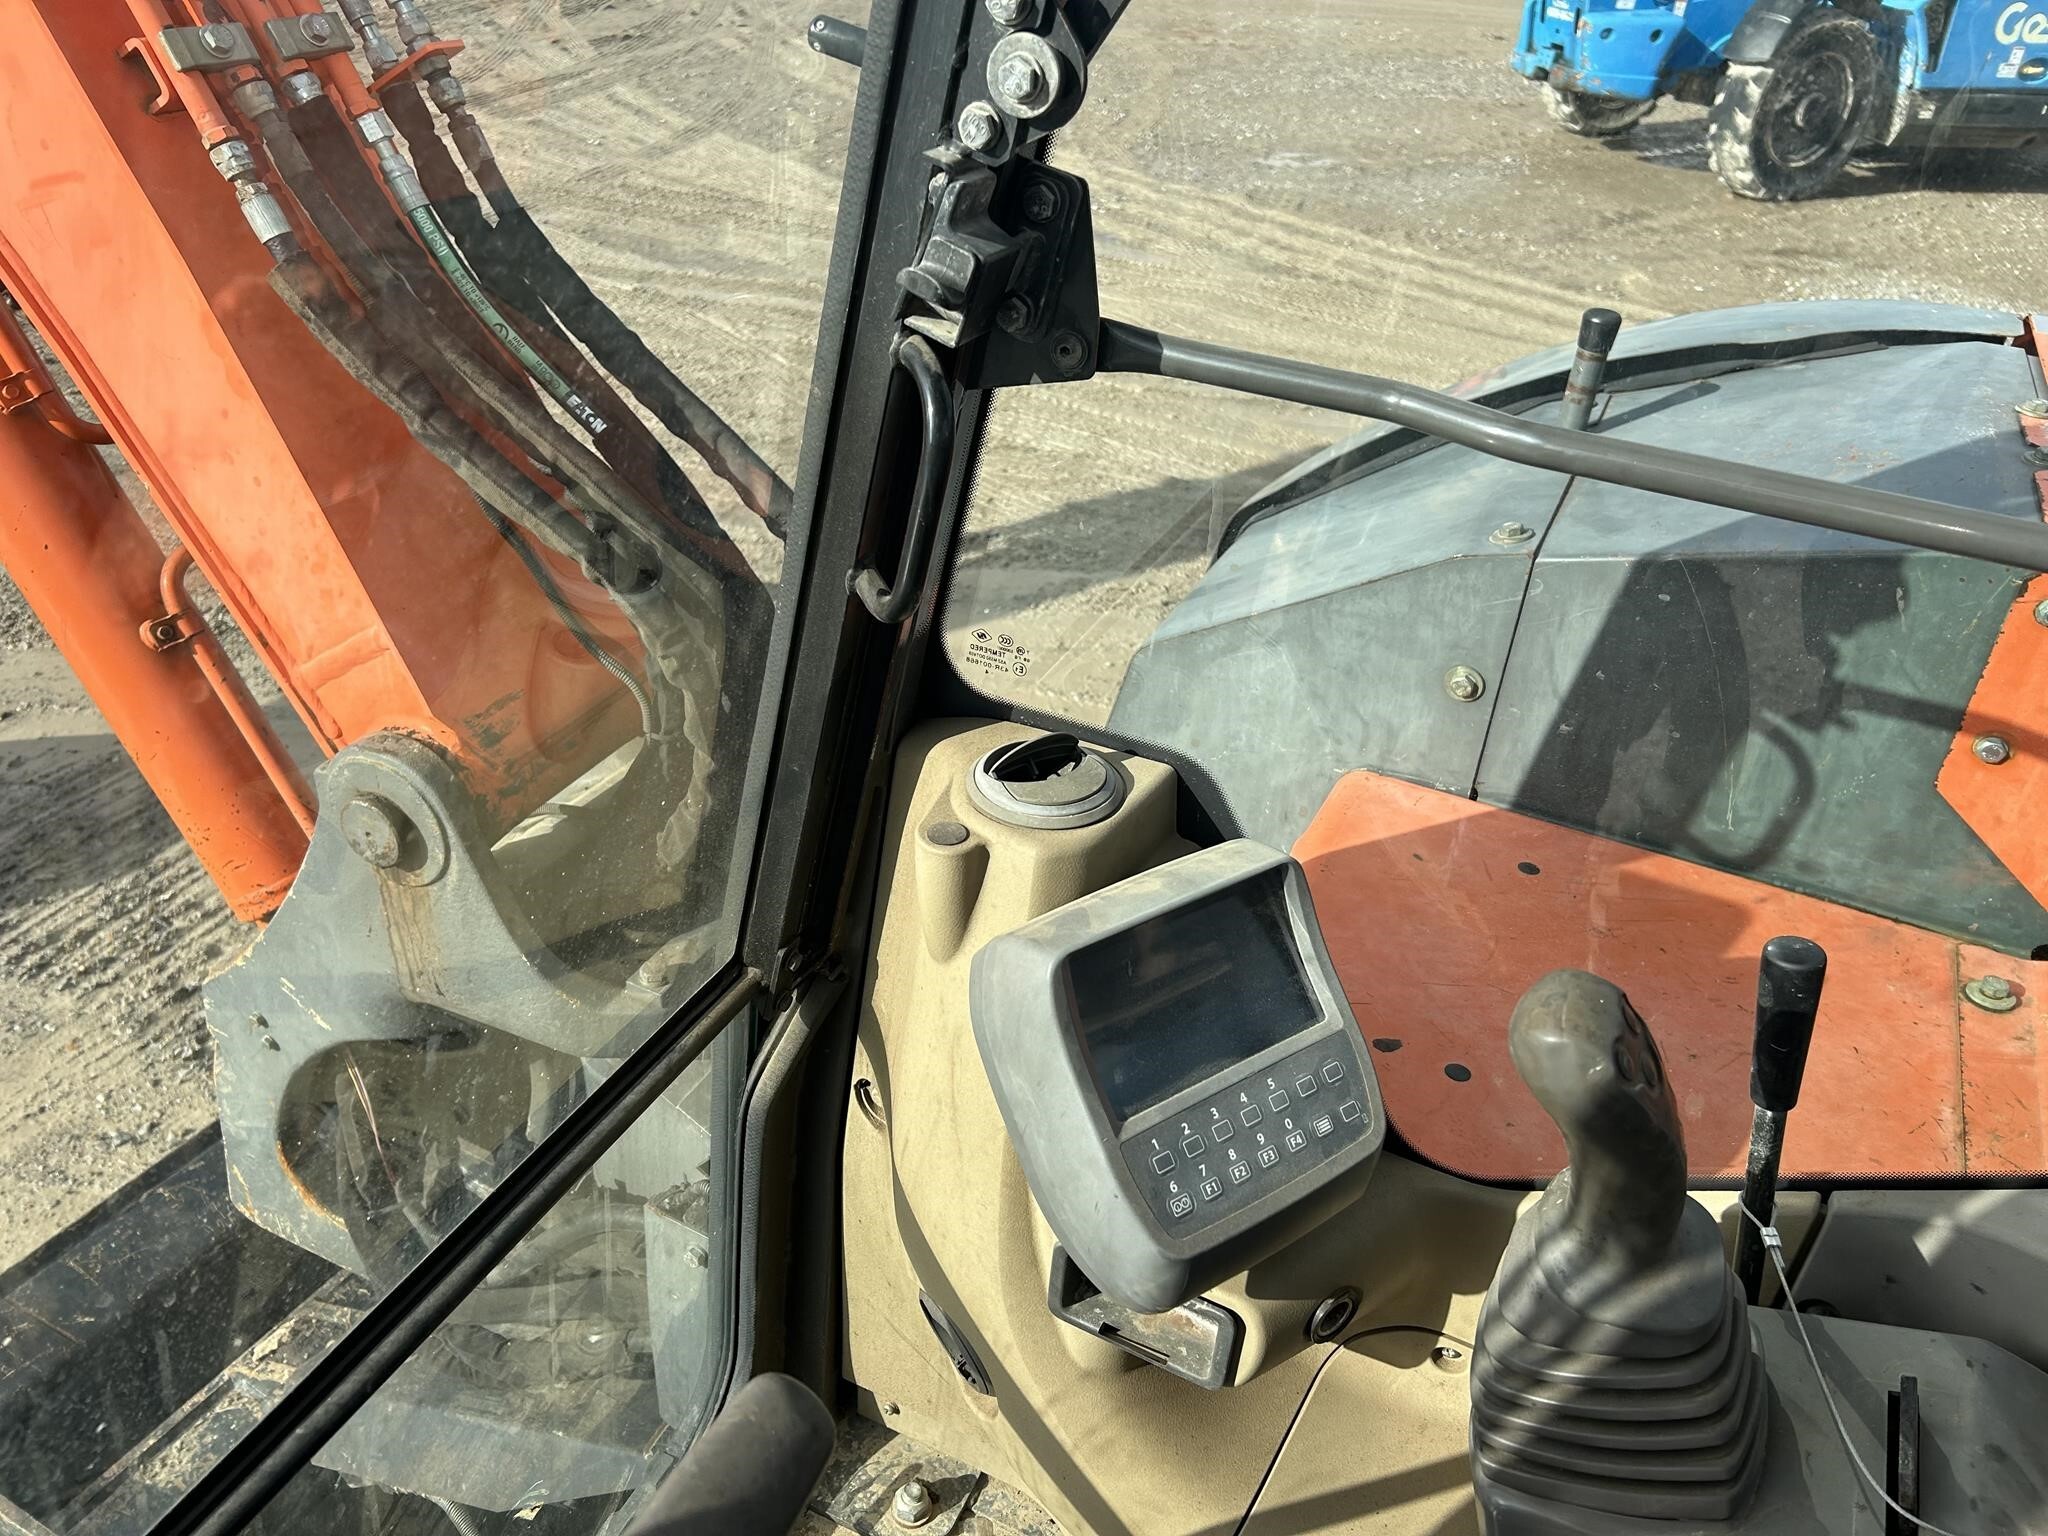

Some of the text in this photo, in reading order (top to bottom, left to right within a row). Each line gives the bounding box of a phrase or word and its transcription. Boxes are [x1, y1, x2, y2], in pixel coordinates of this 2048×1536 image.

[1995, 1, 2048, 45] Ge
[413, 207, 434, 233] 5000
[566, 394, 608, 434] EATON
[1151, 1078, 1275, 1150] 1 2 3 4 5
[1169, 1118, 1293, 1193] 6 7 8 9 0
[1205, 1134, 1303, 1195] F1 F2 F3 F4
